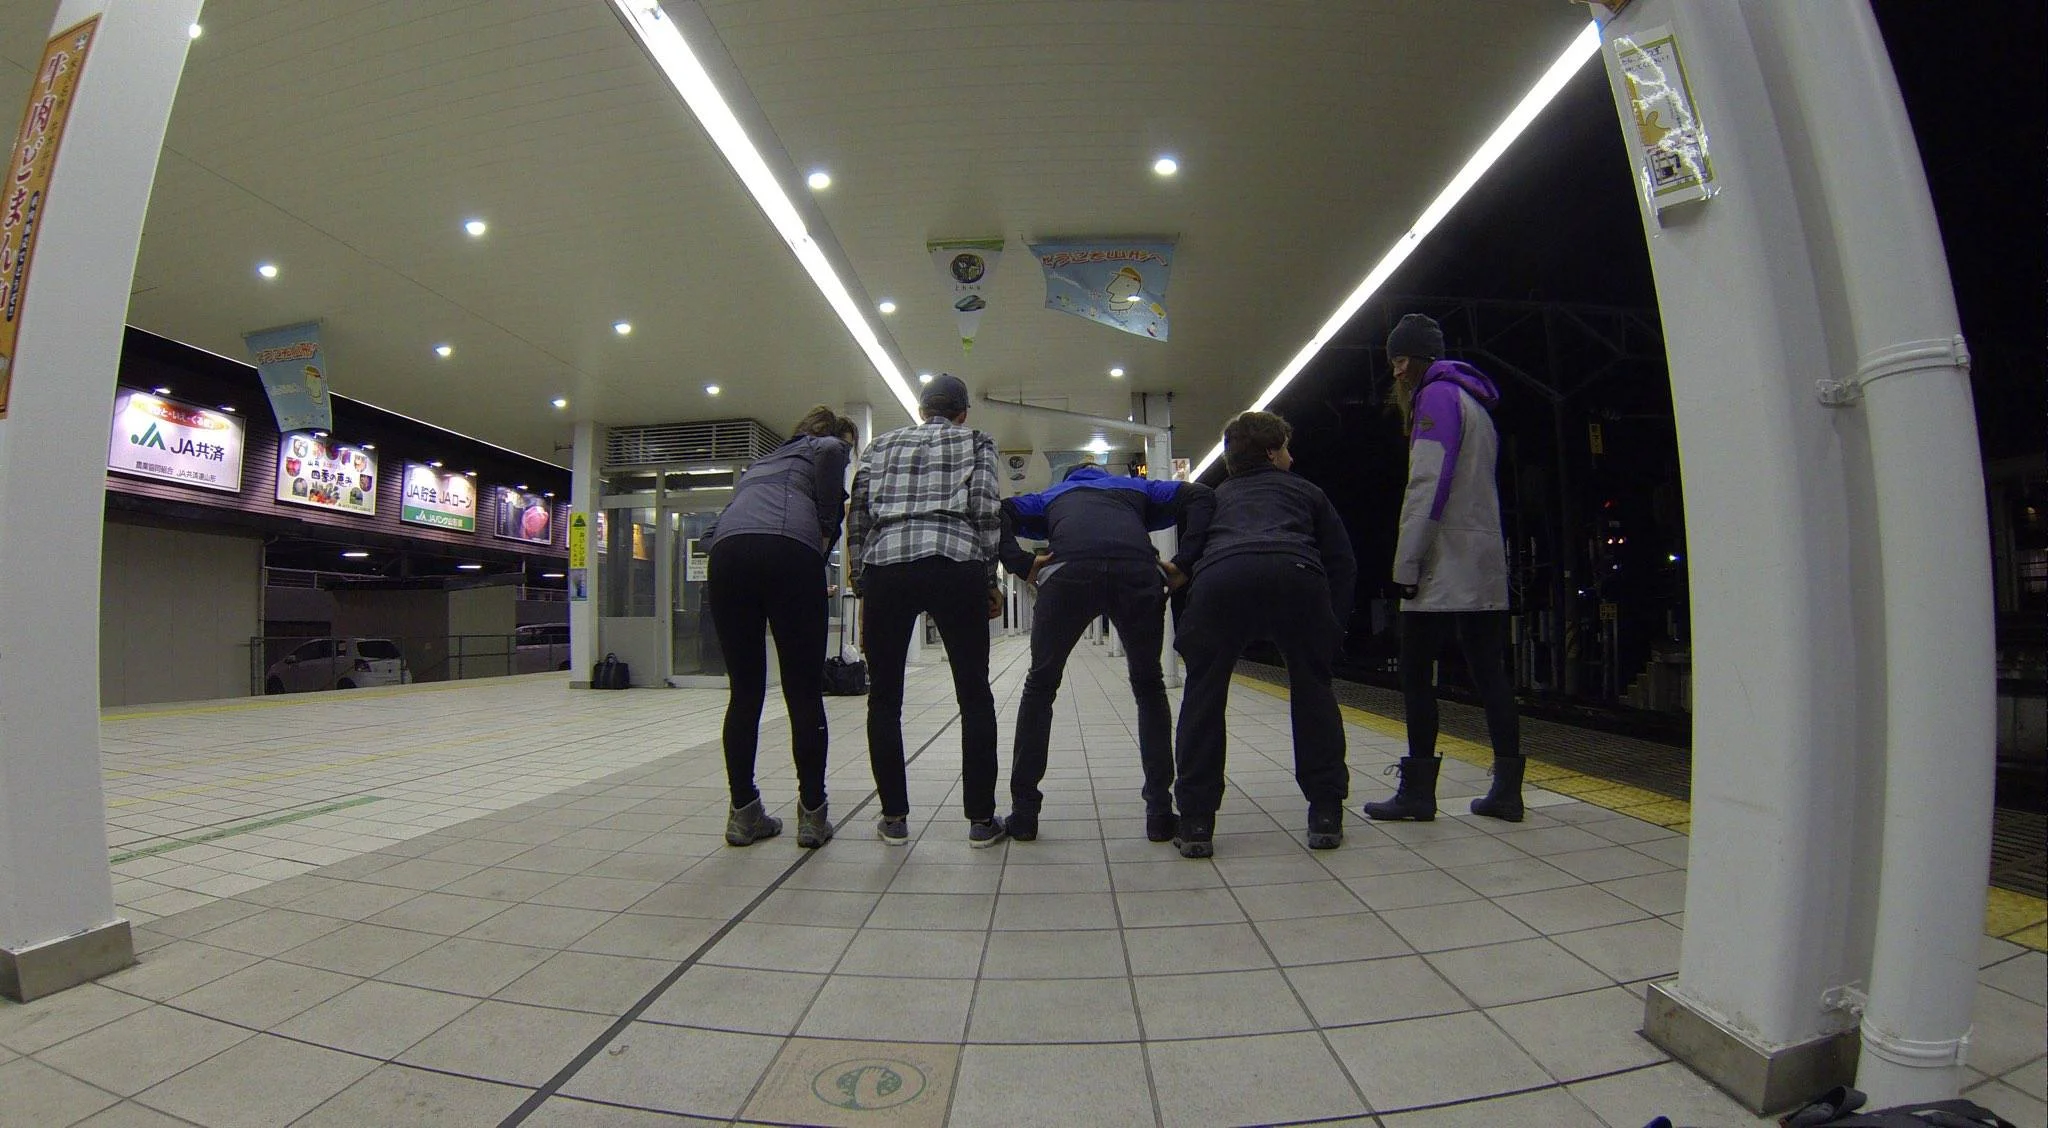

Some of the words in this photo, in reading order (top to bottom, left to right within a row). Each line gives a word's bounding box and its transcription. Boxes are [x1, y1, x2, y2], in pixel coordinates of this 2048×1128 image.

[170, 438, 225, 462] JA共済
[406, 484, 437, 504] JA貯金
[439, 490, 472, 509] JAローン
